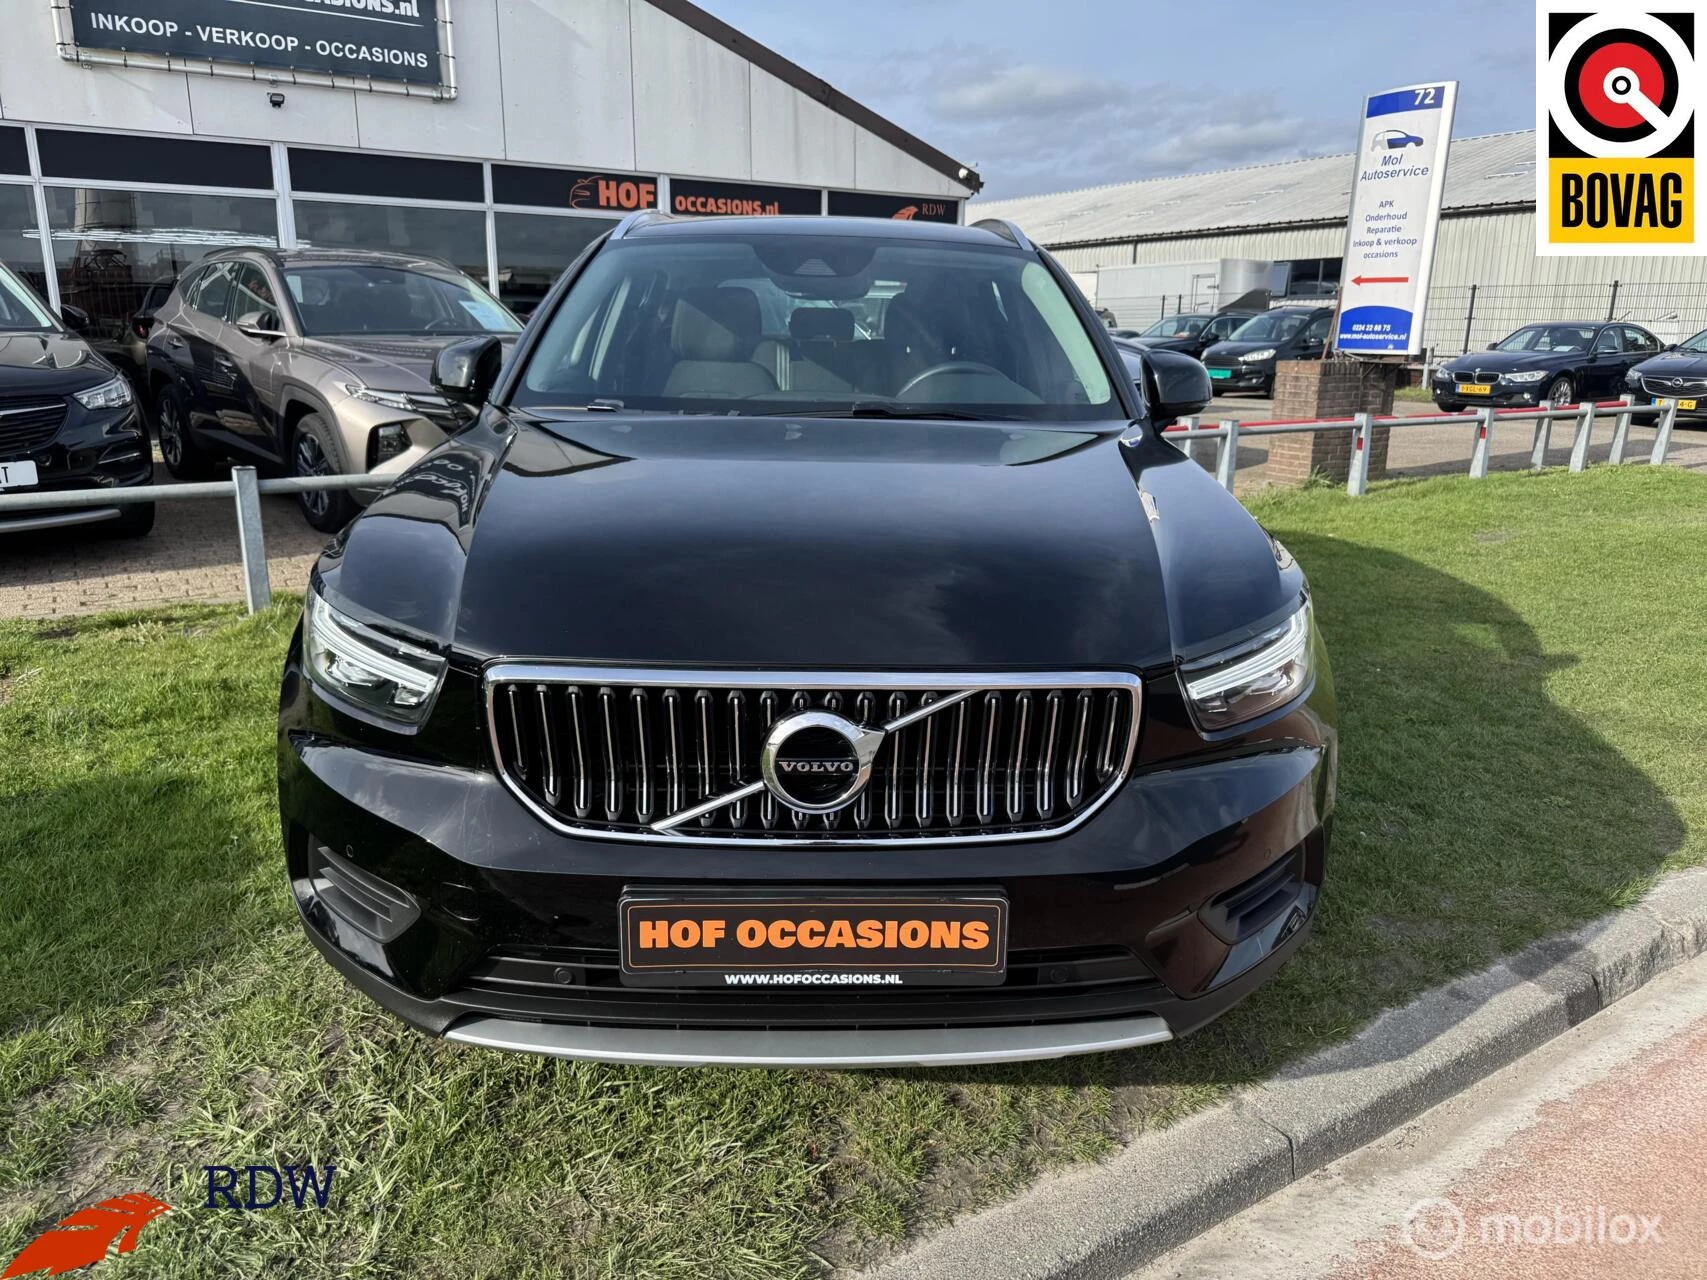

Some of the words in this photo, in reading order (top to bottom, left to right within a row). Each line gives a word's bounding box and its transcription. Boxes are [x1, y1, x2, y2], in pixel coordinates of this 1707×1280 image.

[91, 12, 178, 37] INKOOP
[196, 25, 298, 52] VERKOOP
[315, 40, 428, 68] OCCASIONS
[1414, 88, 1435, 105] 72
[1381, 154, 1403, 166] Mol
[1360, 164, 1429, 182] Autoservice
[598, 180, 655, 209] HOF
[675, 195, 779, 215] OCCASIONS.nl
[922, 203, 945, 216] RDW
[1379, 200, 1395, 208] APK
[1365, 211, 1408, 222] Onderhoud
[1366, 225, 1402, 235] Reparatie
[1376, 238, 1382, 246] &
[1384, 237, 1418, 247] verkoop
[1363, 250, 1399, 259] occasions
[779, 762, 854, 772] VOLVO
[639, 920, 726, 949] HOF
[736, 919, 990, 950] OCCASIONS
[724, 974, 903, 985] WWW.HOFOCCASIONS.NL
